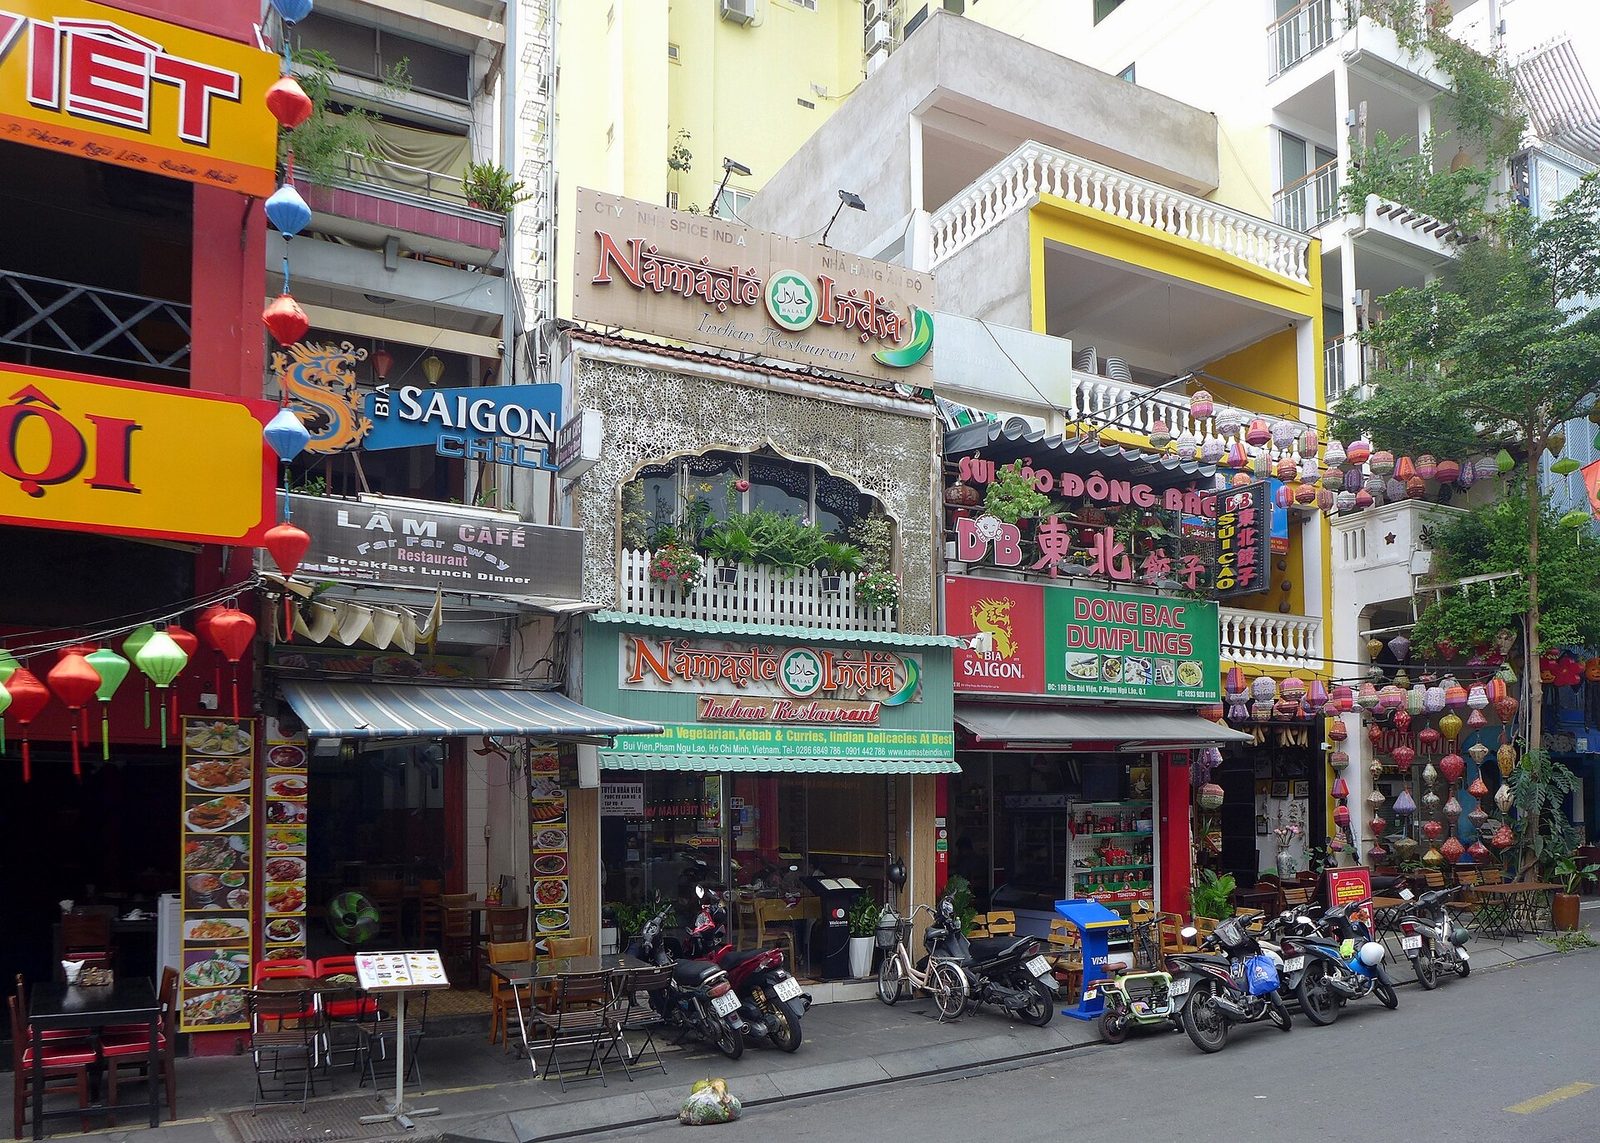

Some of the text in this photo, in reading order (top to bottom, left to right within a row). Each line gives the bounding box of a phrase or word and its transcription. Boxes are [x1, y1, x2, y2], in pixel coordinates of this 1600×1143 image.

[595, 201, 624, 218] CTY
[670, 218, 708, 238] SPICE
[713, 229, 747, 247] INDIA
[822, 256, 846, 272] NHÀ
[592, 229, 904, 344] Namaste India
[694, 312, 857, 363] Indian Restaurant
[374, 383, 390, 417] BIA
[399, 386, 556, 443] SAIGON
[436, 433, 560, 472] CHILL
[1060, 470, 1155, 508] ĐÔNG
[1164, 481, 1216, 518] BẮC
[337, 510, 526, 548] LÂM CAFÉ
[956, 517, 1022, 567] DB
[327, 555, 415, 574] Breakfast
[421, 567, 472, 579] Lunch
[477, 573, 531, 584] Dinner
[356, 536, 510, 571] Far Far away
[397, 548, 468, 568] Restaurant
[1074, 596, 1186, 629] DONG BAC
[1066, 623, 1193, 656] DUMPLINGS
[627, 637, 897, 696] Namaste India
[963, 660, 1022, 679] SAIGON
[984, 652, 1002, 661] BIA
[700, 696, 881, 723] Indian Restaurant
[623, 741, 635, 751] Bui
[676, 742, 691, 754] Ngu
[709, 744, 719, 753] Ho
[720, 743, 732, 753] Chi
[795, 745, 812, 755] 0286
[845, 746, 860, 755] 0901
[861, 746, 873, 755] 442
[888, 747, 951, 757] www.namasteindia.vn
[775, 729, 783, 741] &
[786, 730, 827, 743] Curries,
[867, 731, 918, 744] Delicacies
[920, 733, 930, 744] At
[932, 733, 952, 745] Best
[1091, 956, 1108, 966] VISA
[720, 1000, 738, 1014] 5795
